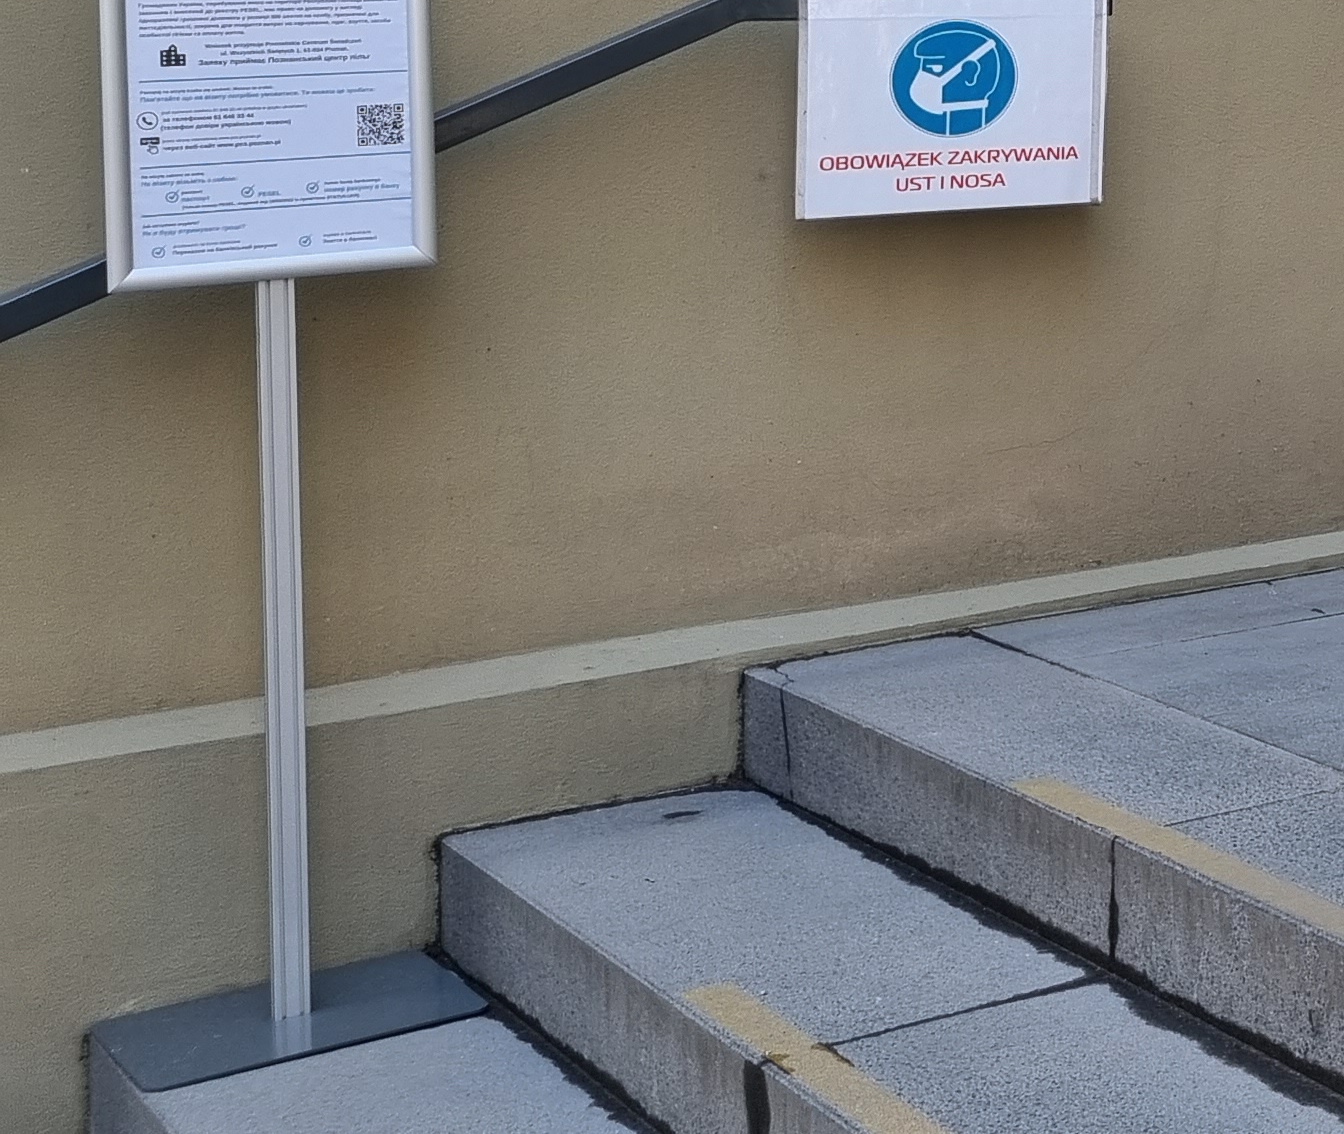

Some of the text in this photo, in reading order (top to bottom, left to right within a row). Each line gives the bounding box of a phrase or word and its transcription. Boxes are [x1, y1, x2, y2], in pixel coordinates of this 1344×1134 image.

[819, 146, 1079, 171] OBOWIĄZEK ZAKRYWANIA
[896, 173, 1006, 192] UST I NOSA
